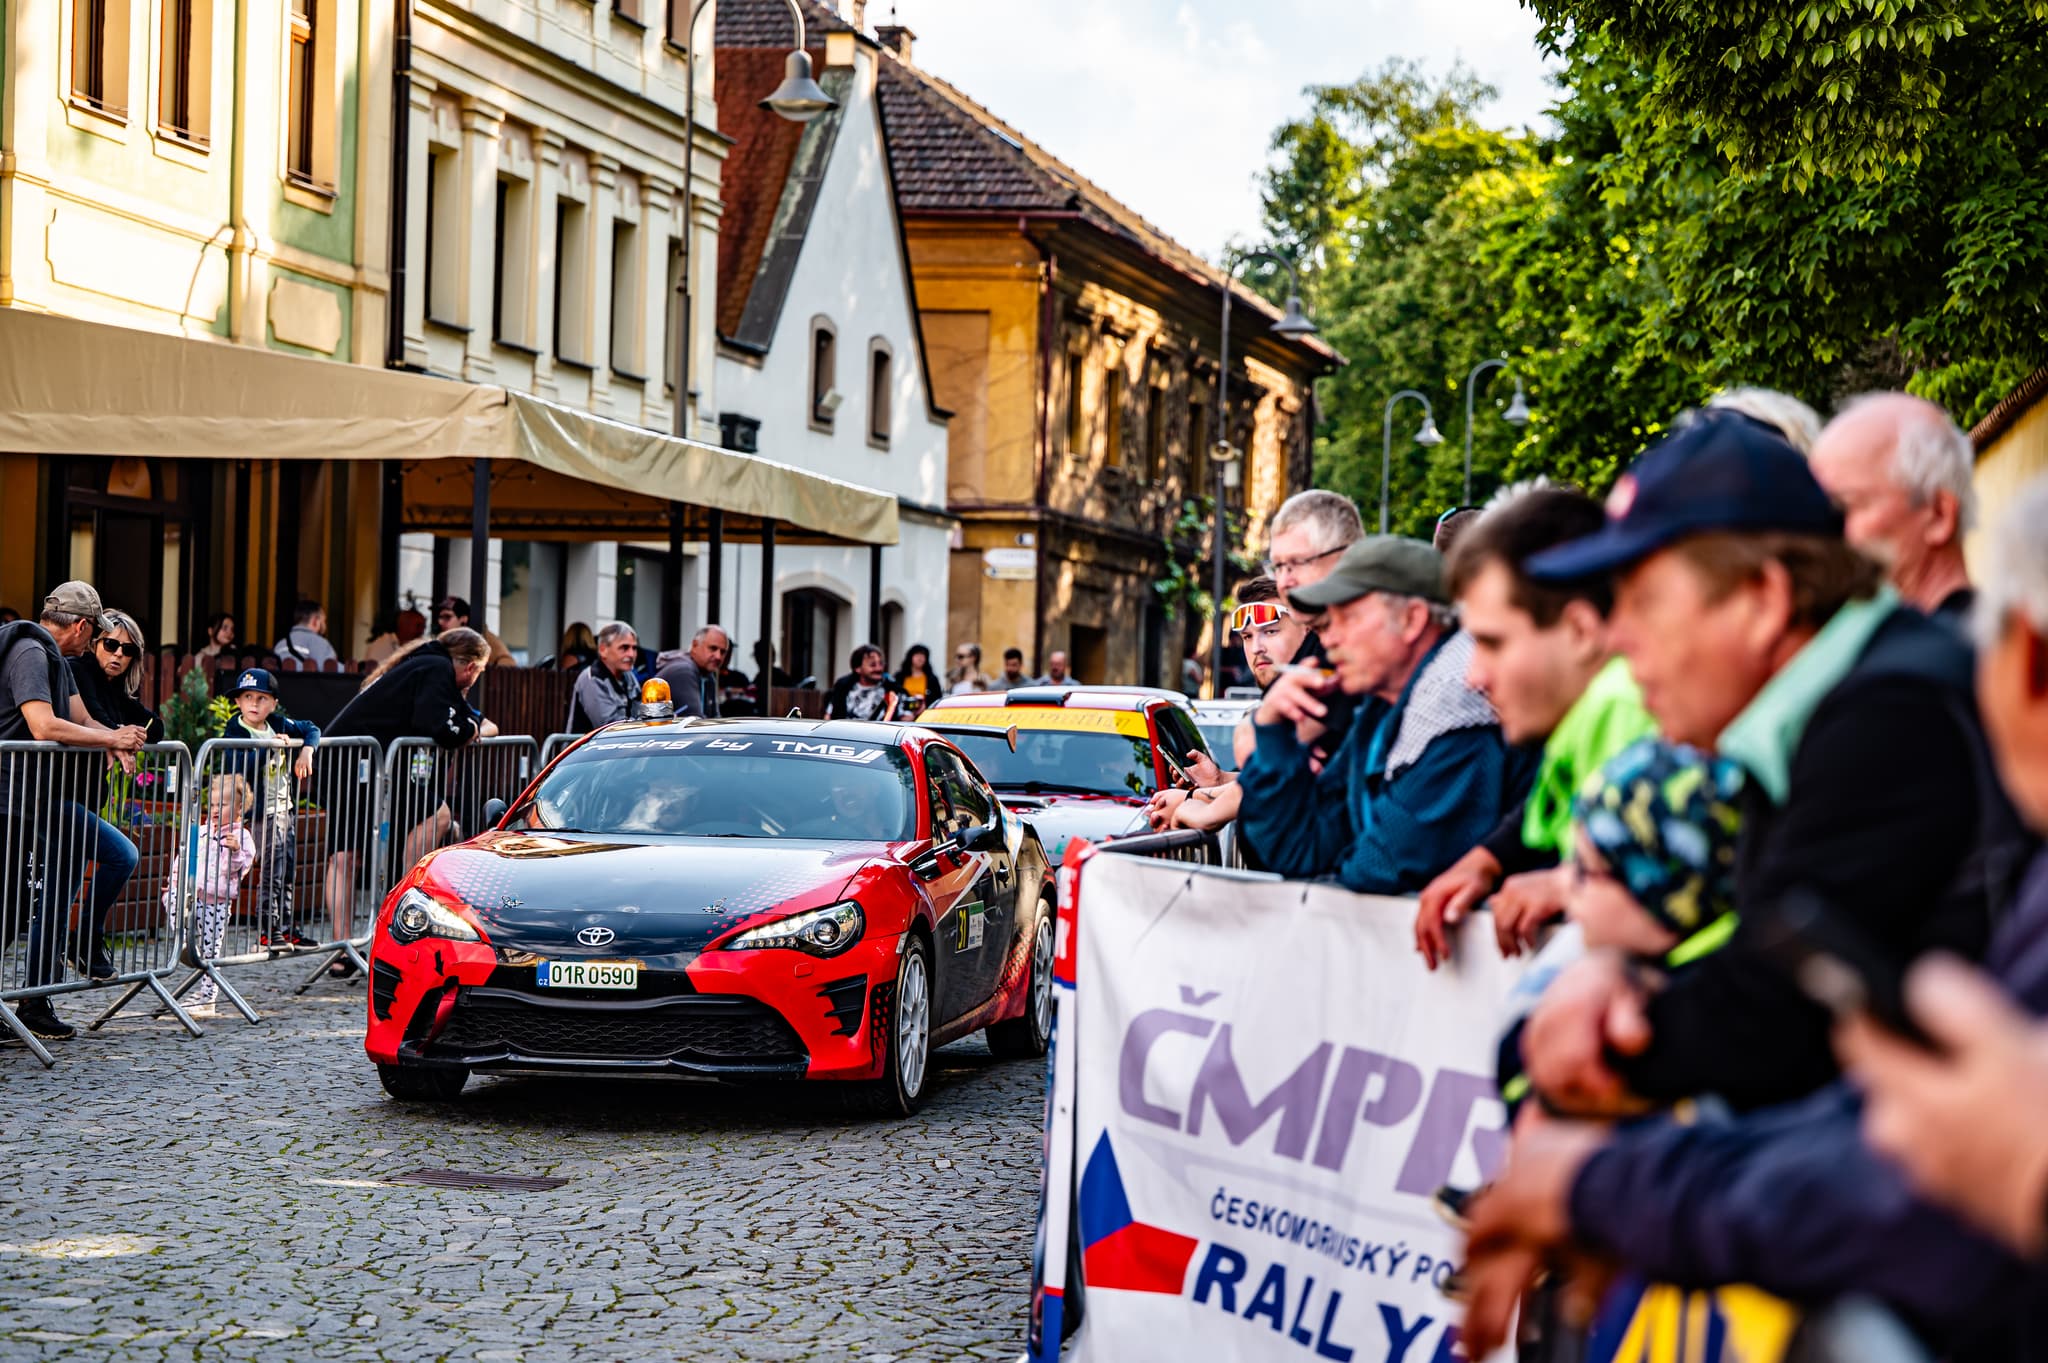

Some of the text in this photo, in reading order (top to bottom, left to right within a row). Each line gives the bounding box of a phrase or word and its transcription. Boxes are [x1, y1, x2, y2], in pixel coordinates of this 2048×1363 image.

[583, 738, 693, 752] racing
[705, 738, 753, 751] by
[538, 978, 548, 986] CZ
[552, 965, 634, 985] 01R 0590
